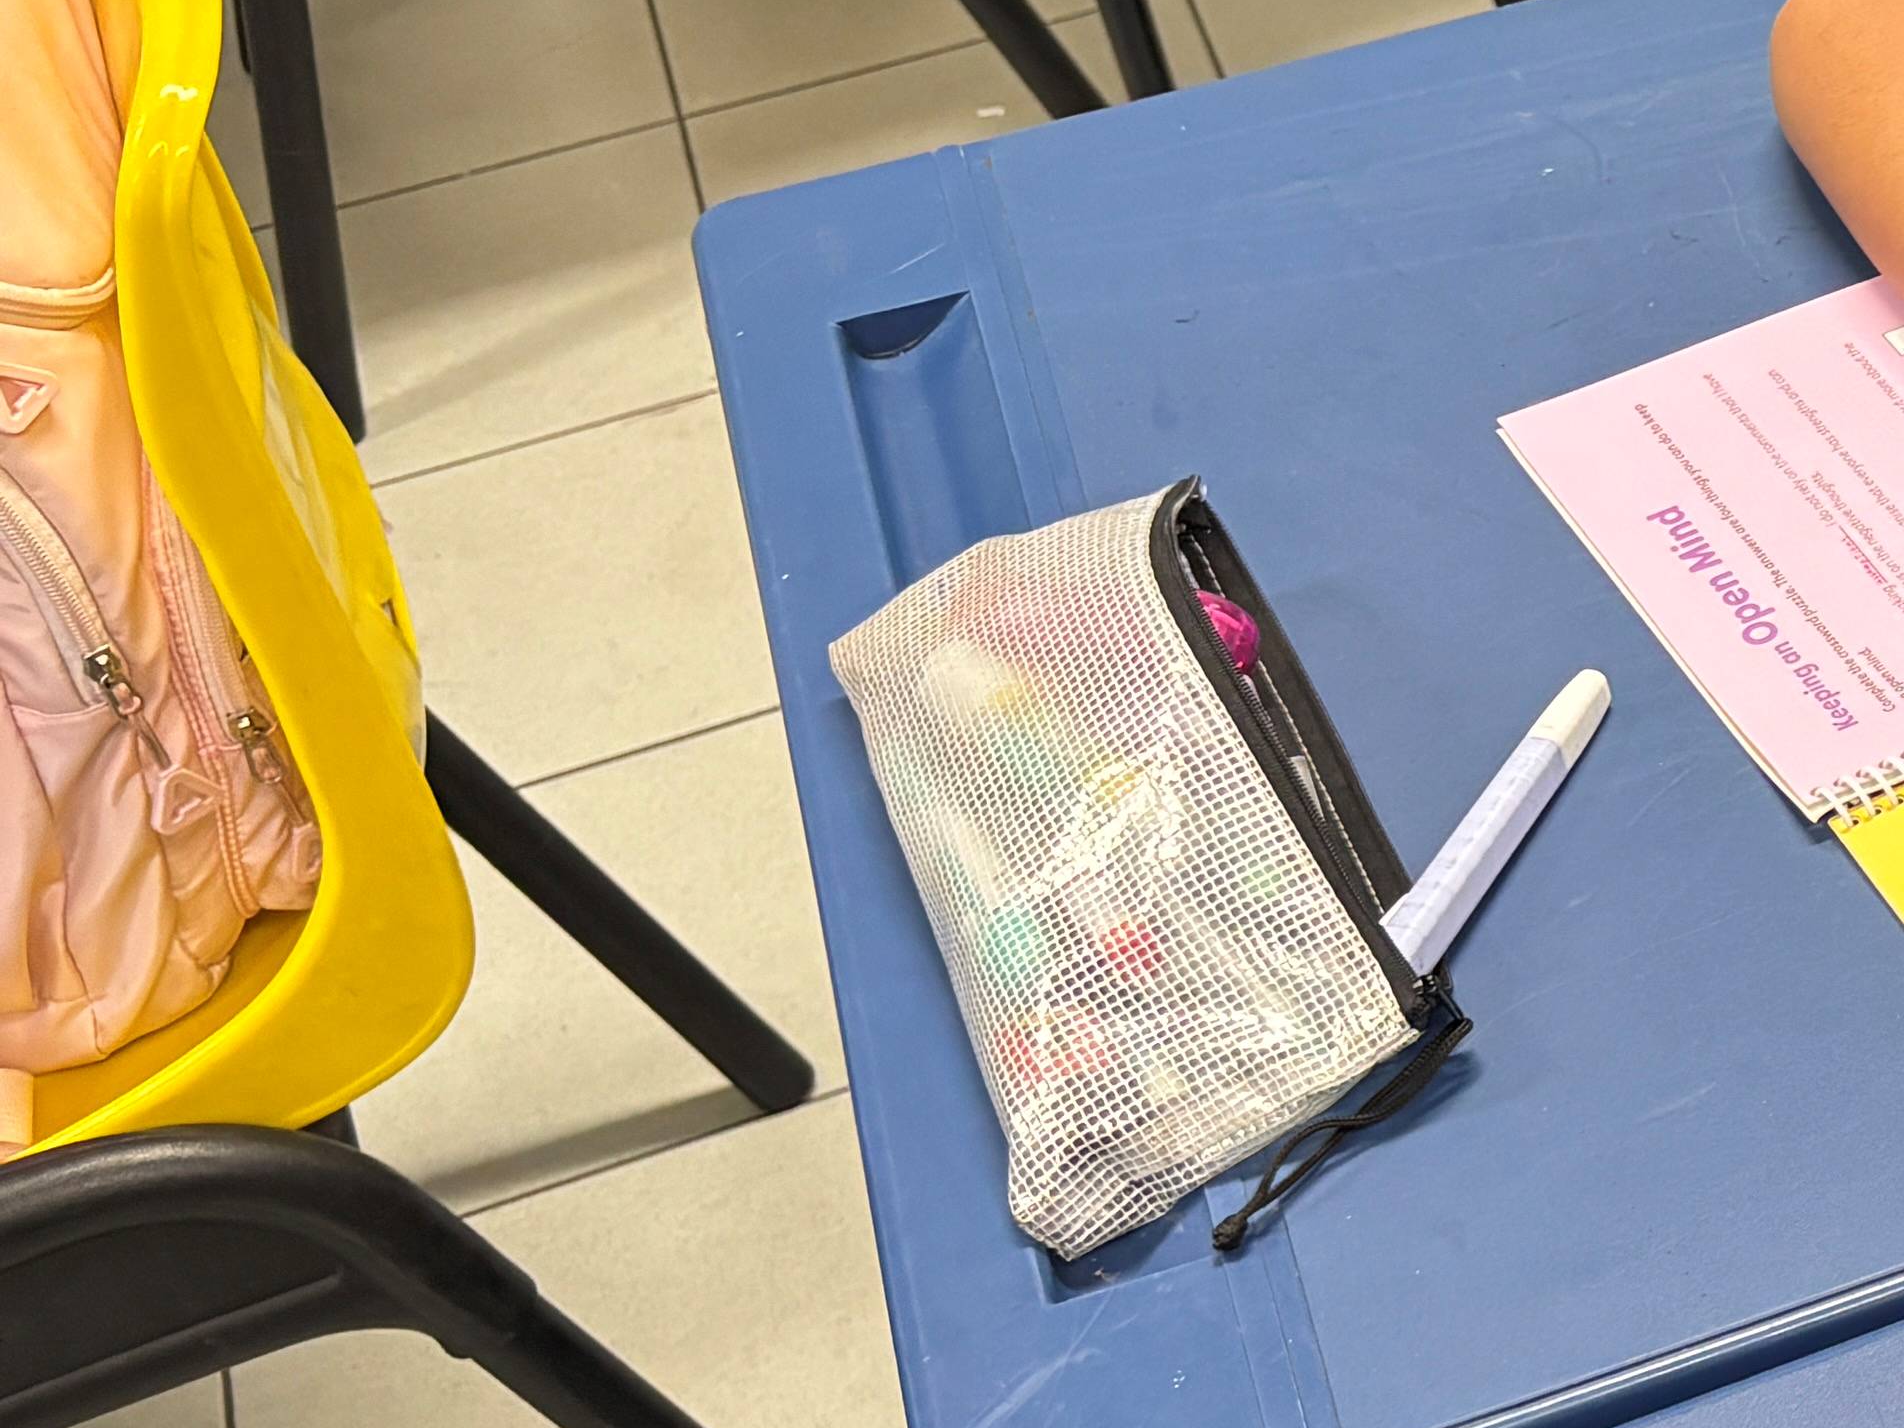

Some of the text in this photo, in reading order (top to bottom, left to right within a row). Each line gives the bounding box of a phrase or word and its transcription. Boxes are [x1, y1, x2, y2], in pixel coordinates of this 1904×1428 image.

[1645, 504, 1859, 731] Keeping an Open Mind
